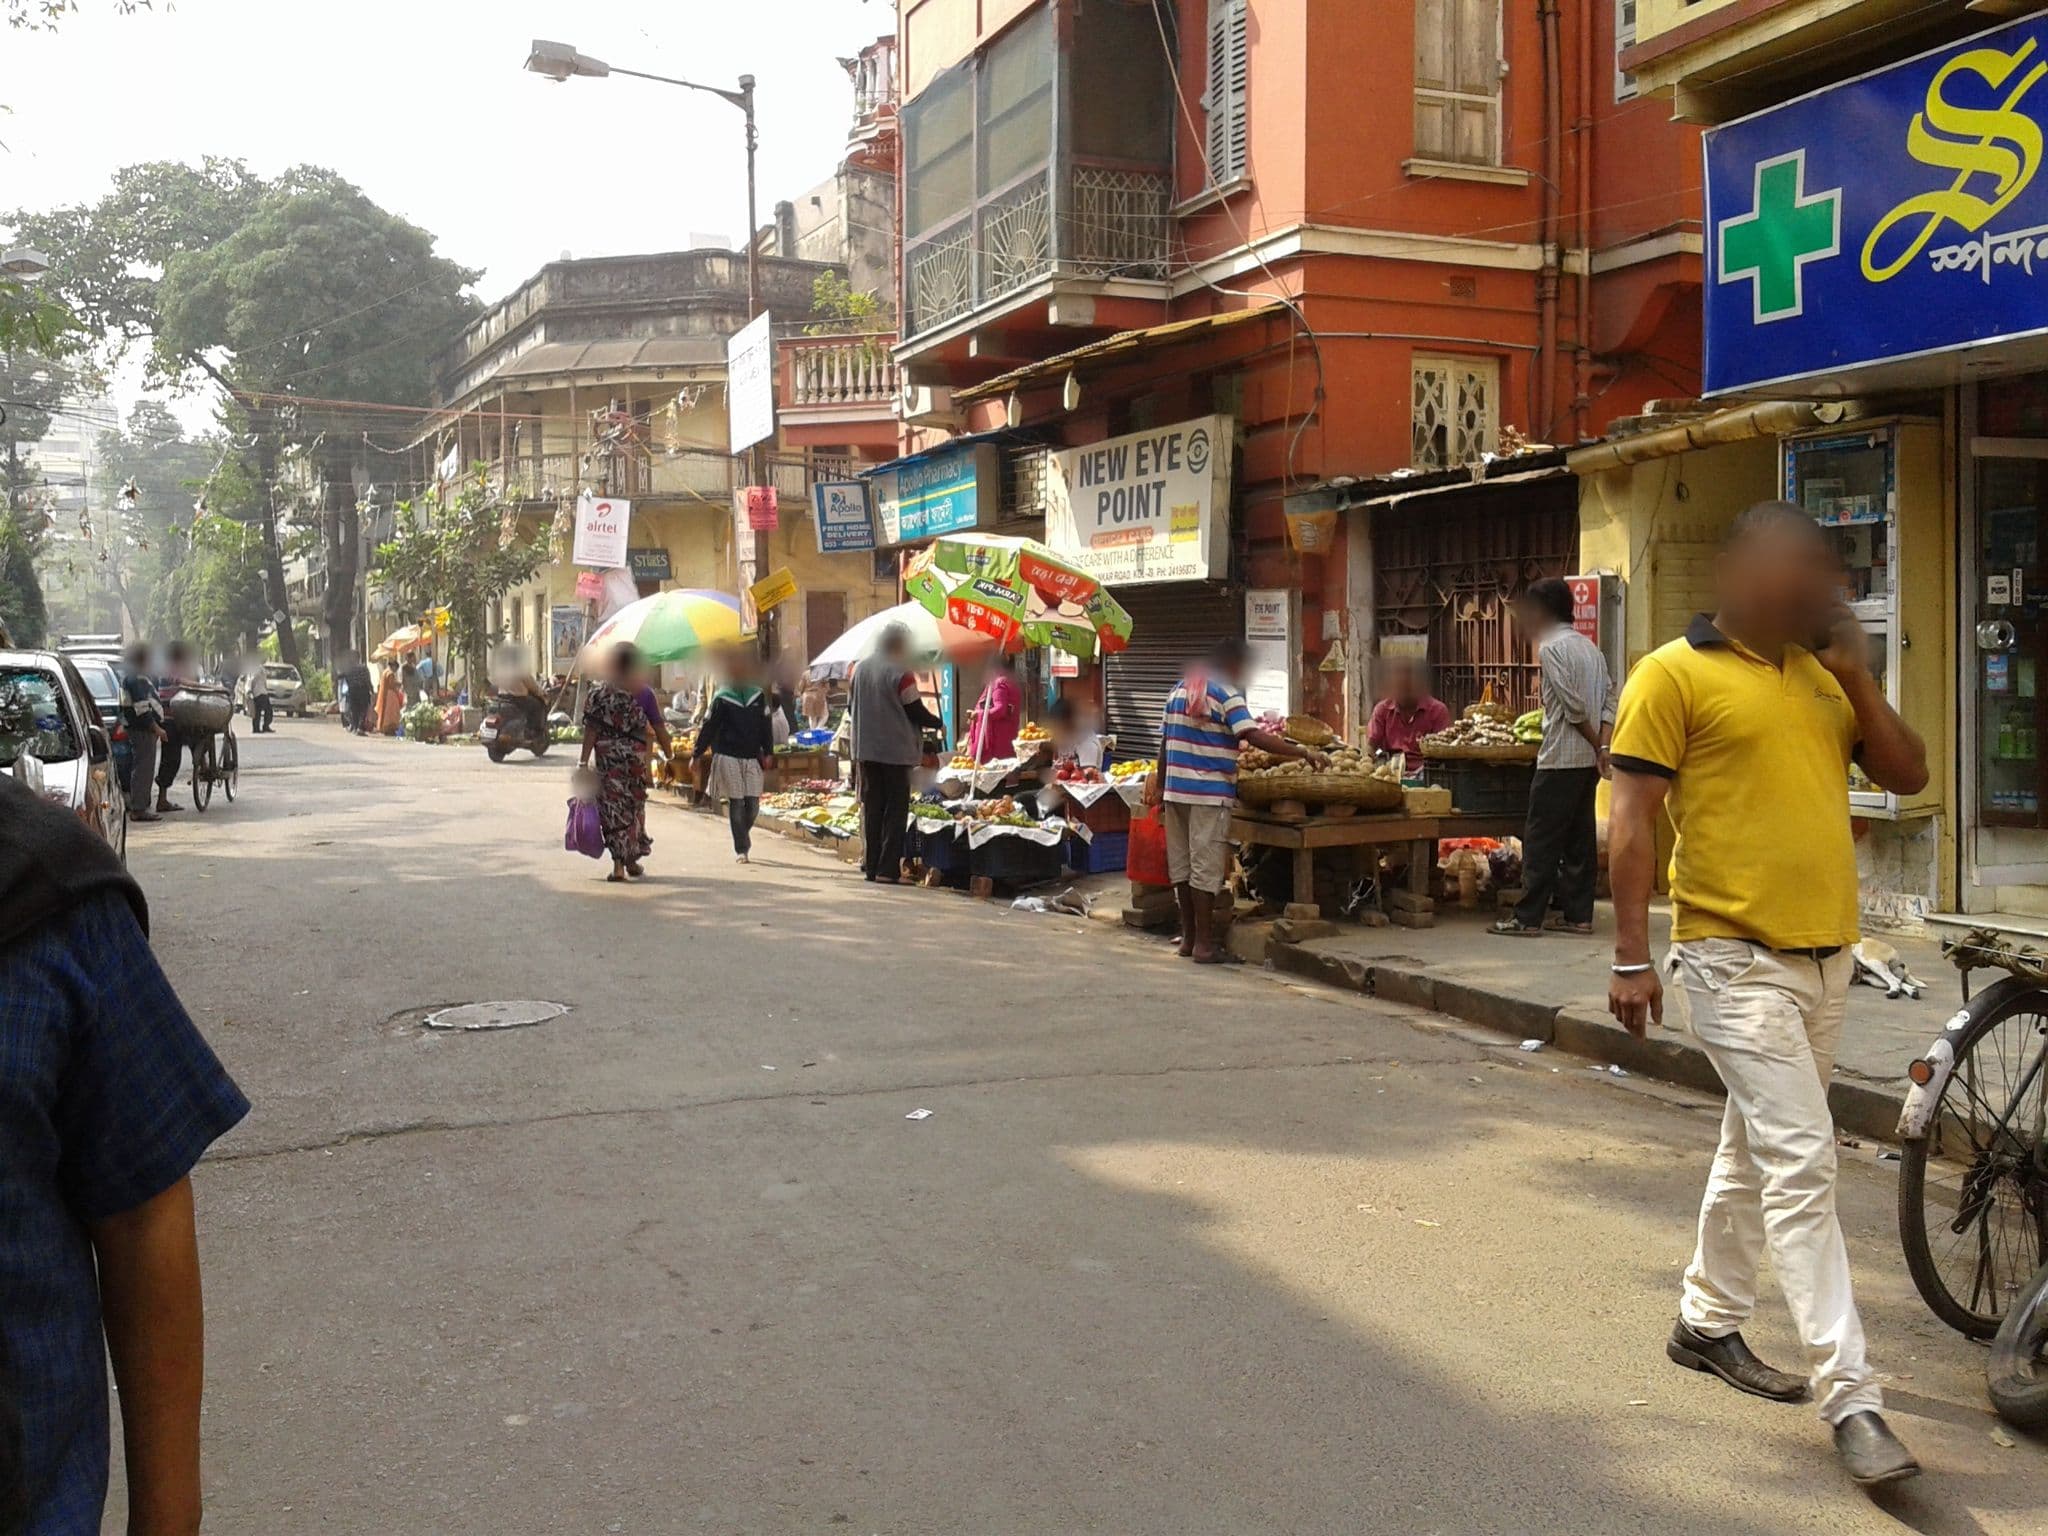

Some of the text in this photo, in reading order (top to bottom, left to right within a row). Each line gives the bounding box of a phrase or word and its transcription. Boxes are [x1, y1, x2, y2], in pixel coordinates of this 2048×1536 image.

[1079, 432, 1183, 488] NEW EYE
[923, 461, 962, 485] Pharmacy
[830, 503, 862, 517] Apollo
[1097, 480, 1167, 526] POINT
[586, 520, 617, 534] airtel
[826, 530, 869, 538] DELIVERY
[1103, 550, 1123, 566] WITH
[1130, 544, 1175, 562] DIFFERENCE
